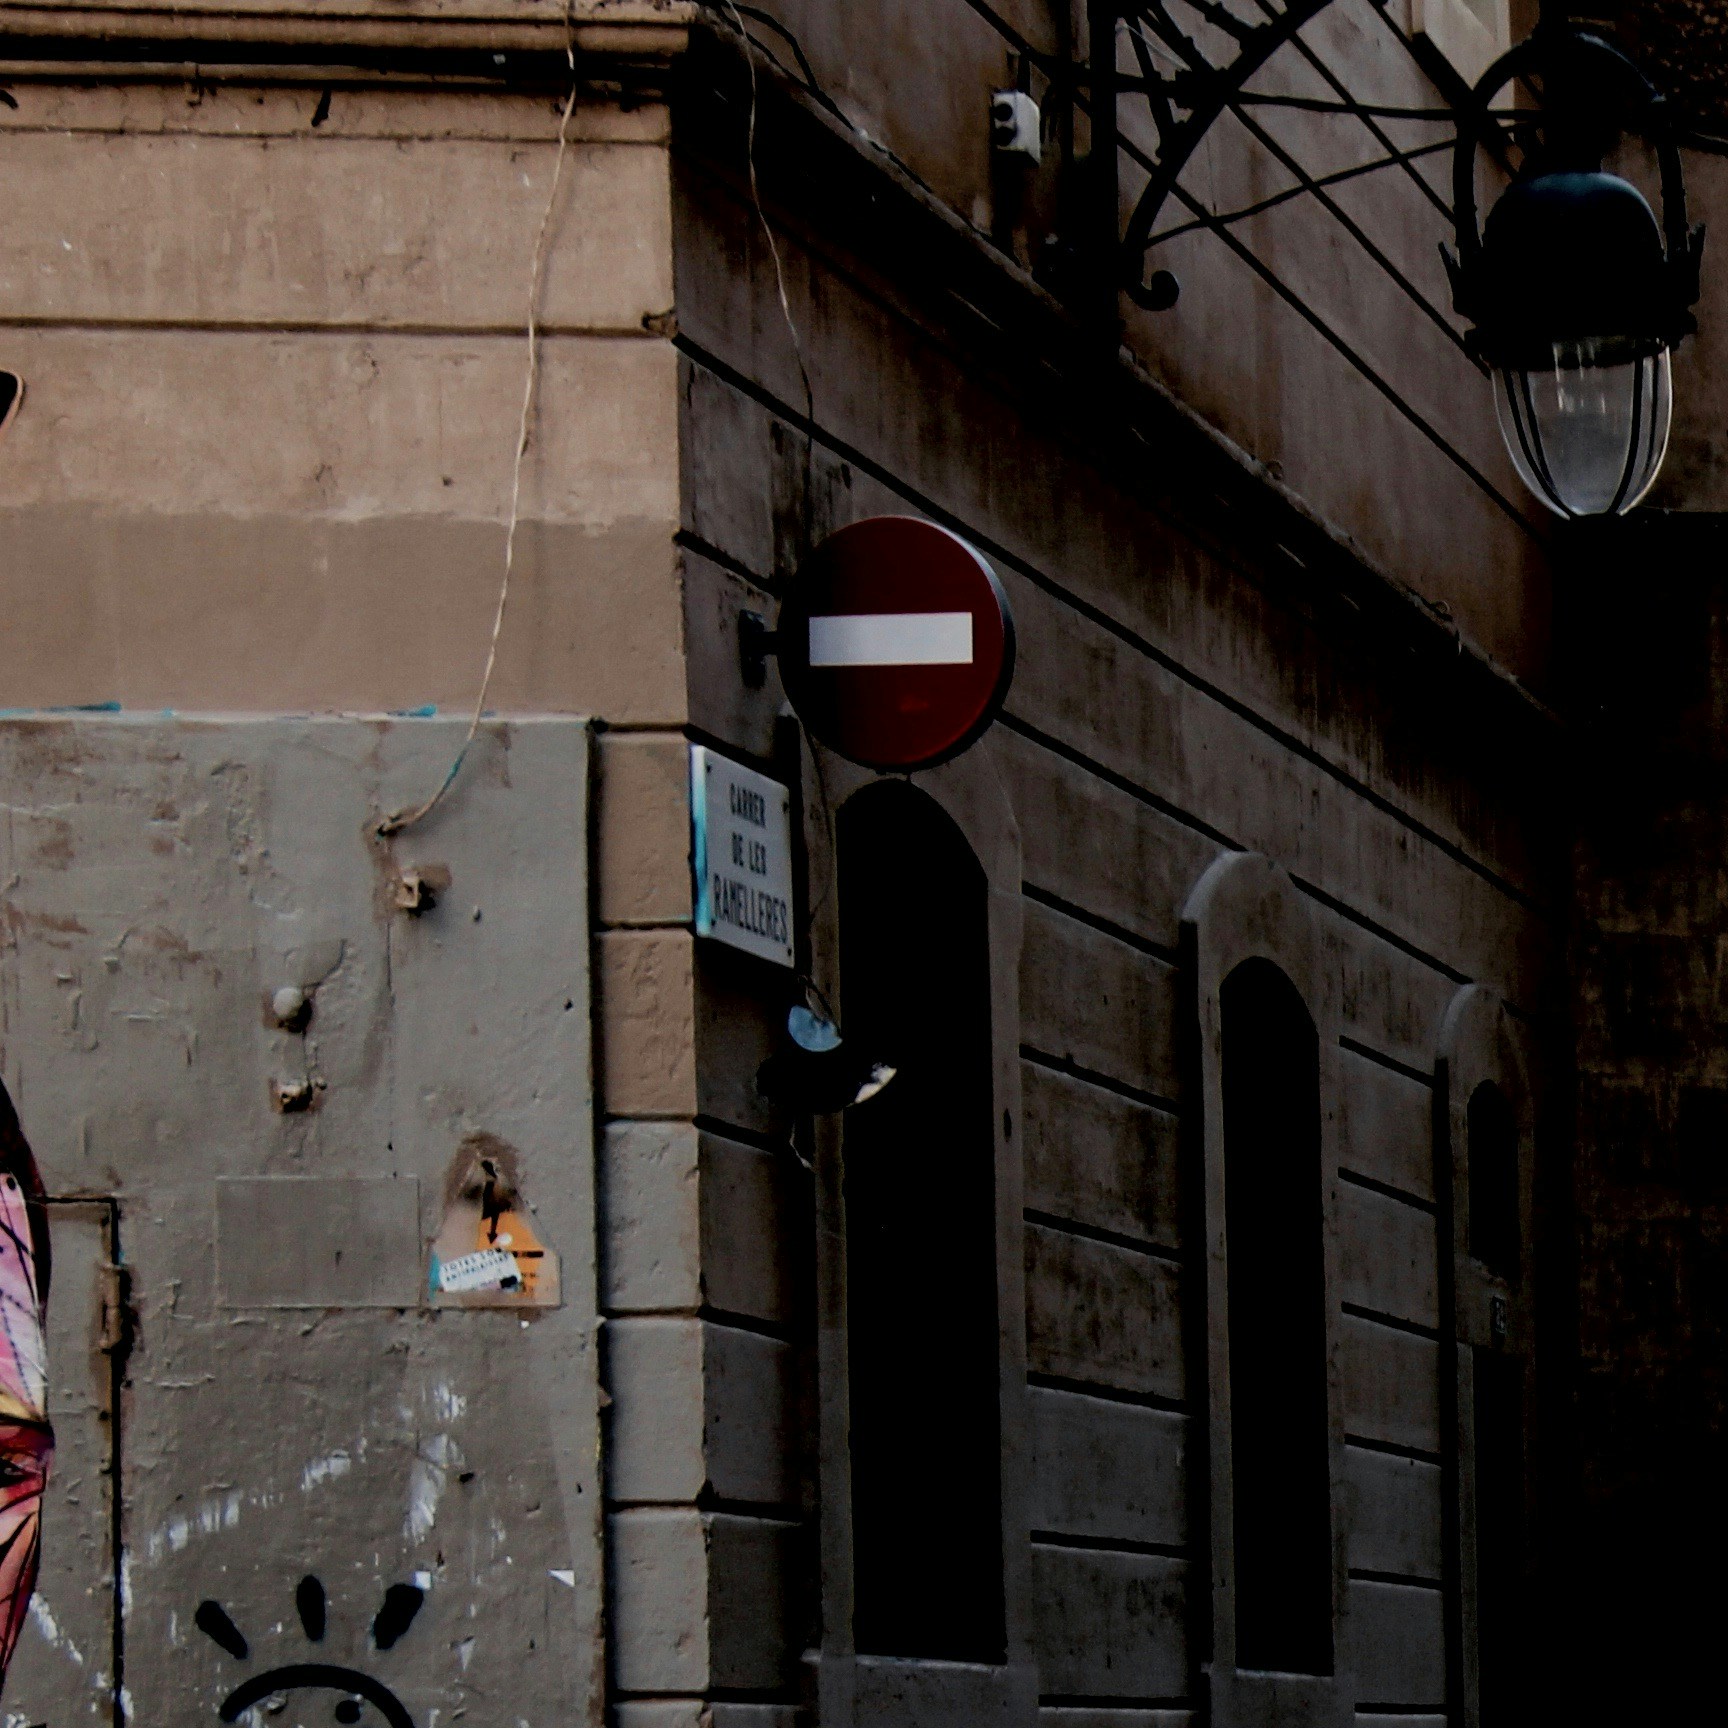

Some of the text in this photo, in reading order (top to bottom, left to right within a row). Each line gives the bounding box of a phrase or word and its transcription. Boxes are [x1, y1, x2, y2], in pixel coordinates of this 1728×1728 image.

[730, 782, 767, 829] CARRER
[731, 832, 768, 877] DE LES
[713, 874, 788, 944] RAMELLERES
